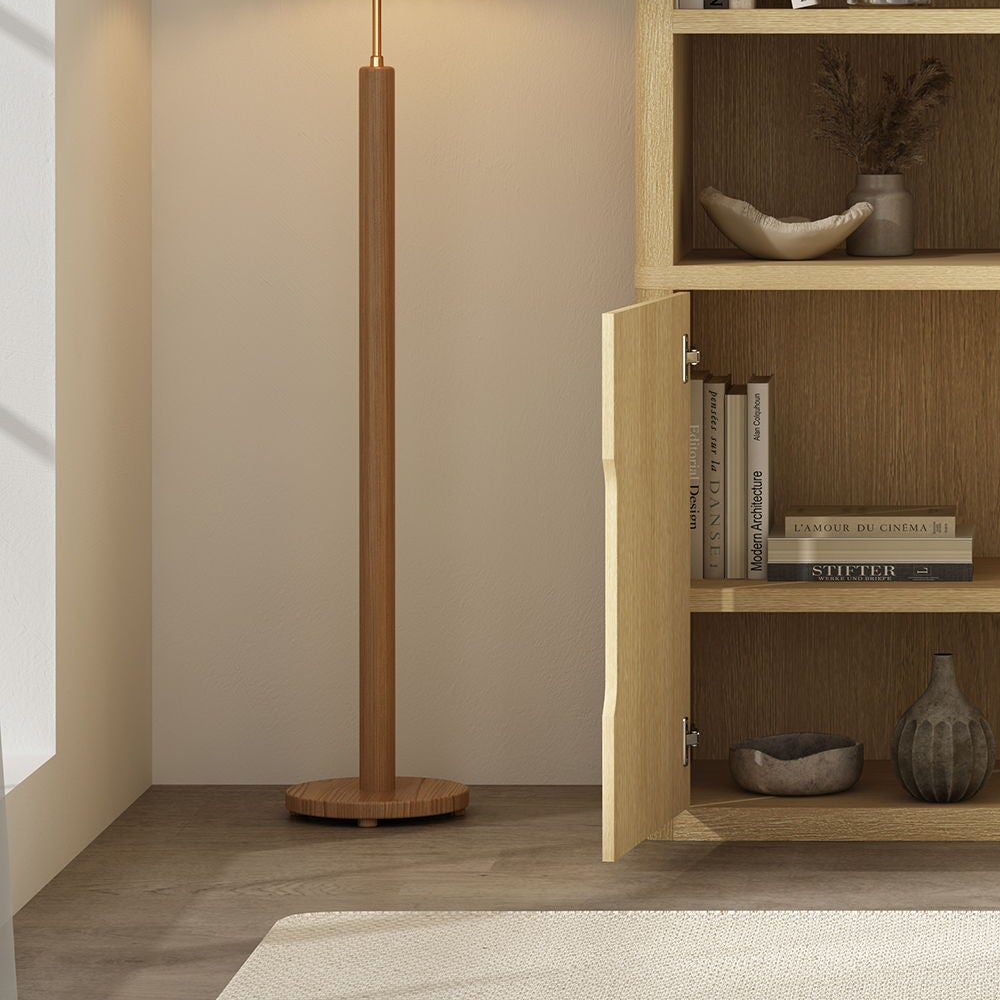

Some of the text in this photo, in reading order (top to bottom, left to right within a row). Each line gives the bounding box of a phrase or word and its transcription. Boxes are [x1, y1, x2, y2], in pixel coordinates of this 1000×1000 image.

[753, 427, 761, 442] Alan
[711, 460, 720, 472] la
[750, 470, 763, 572] Modern Architecture
[857, 523, 875, 532] DU
[811, 564, 897, 577] STIFTER
